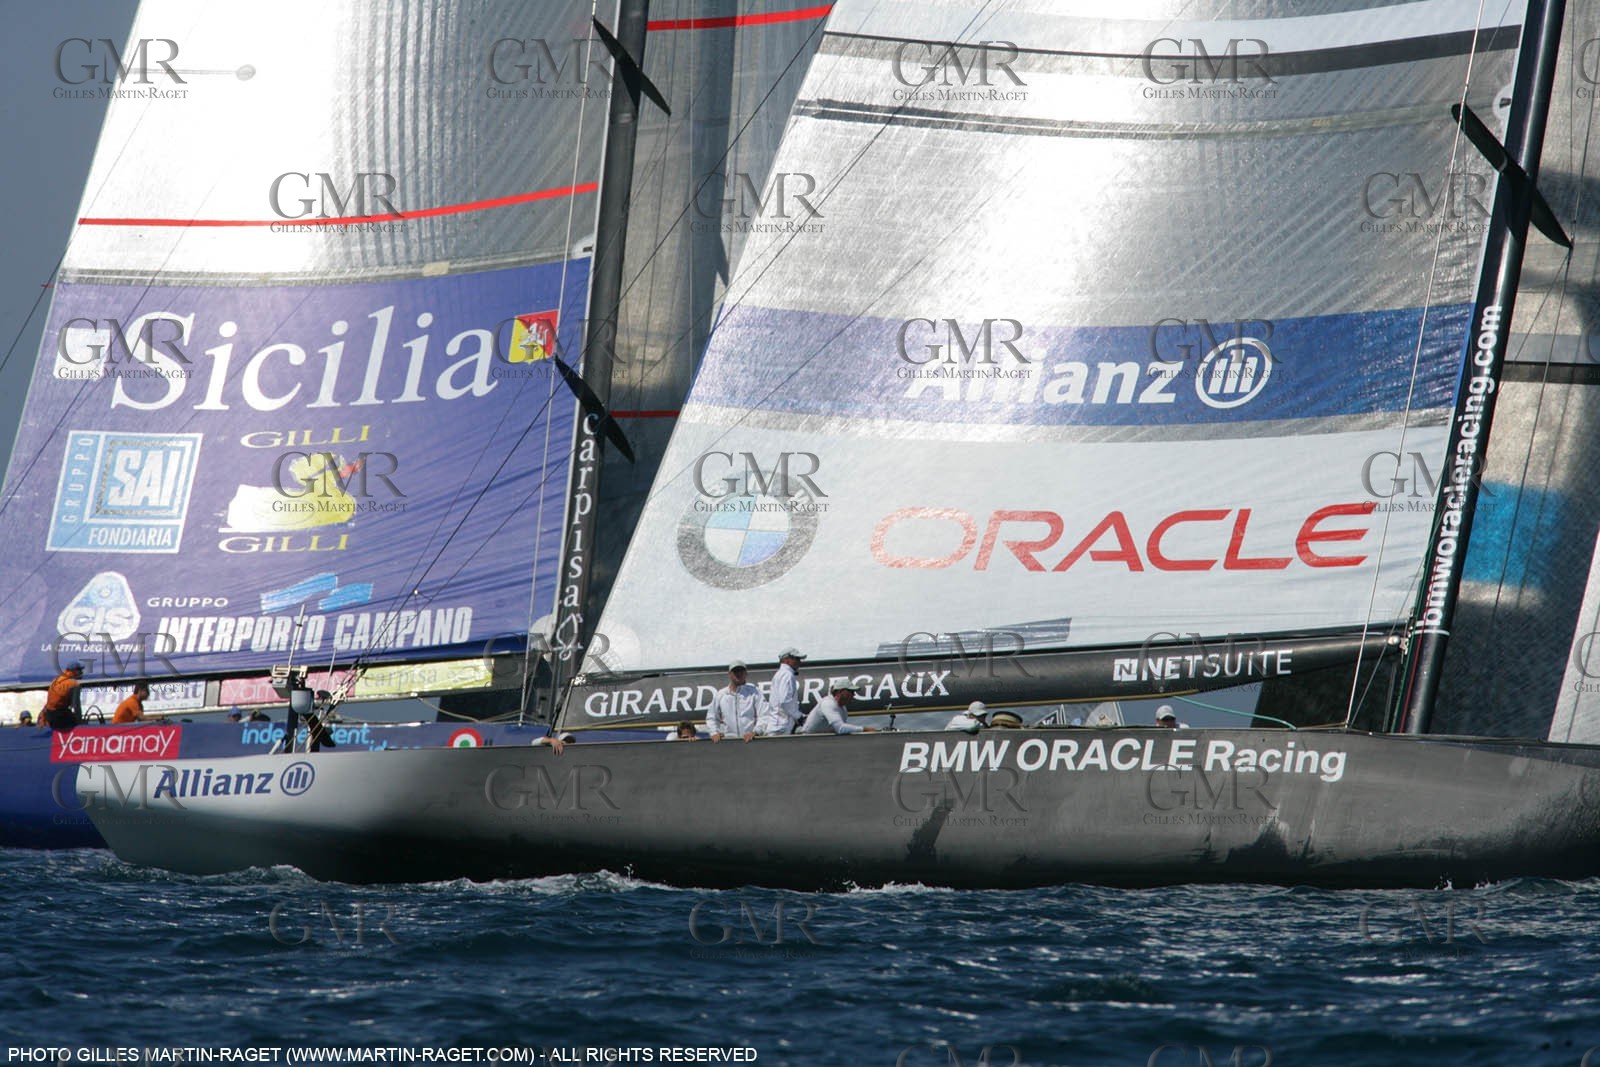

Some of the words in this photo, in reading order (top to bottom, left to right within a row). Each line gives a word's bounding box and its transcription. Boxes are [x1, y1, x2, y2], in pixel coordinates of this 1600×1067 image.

[111, 305, 498, 411] Sicilia
[903, 345, 1183, 405] Allianz
[240, 425, 370, 448] GILLI
[62, 437, 94, 524] GRUPPO
[107, 449, 182, 507] SAI
[1416, 304, 1502, 627] bmworacleracing.com
[563, 412, 600, 607] carpisa
[88, 527, 172, 547] FONDIARIA
[218, 534, 349, 553] GILLI
[870, 503, 1378, 572] ORACLE
[147, 597, 229, 608] GRUPPO
[154, 613, 327, 654] INTERPORTO
[333, 606, 472, 651] CAMPANO
[1142, 650, 1293, 681] NETSUITE
[153, 767, 274, 799] Allianz
[900, 741, 1010, 772] BMW
[1017, 738, 1196, 771] ORACLE
[1205, 740, 1347, 783] Racing
